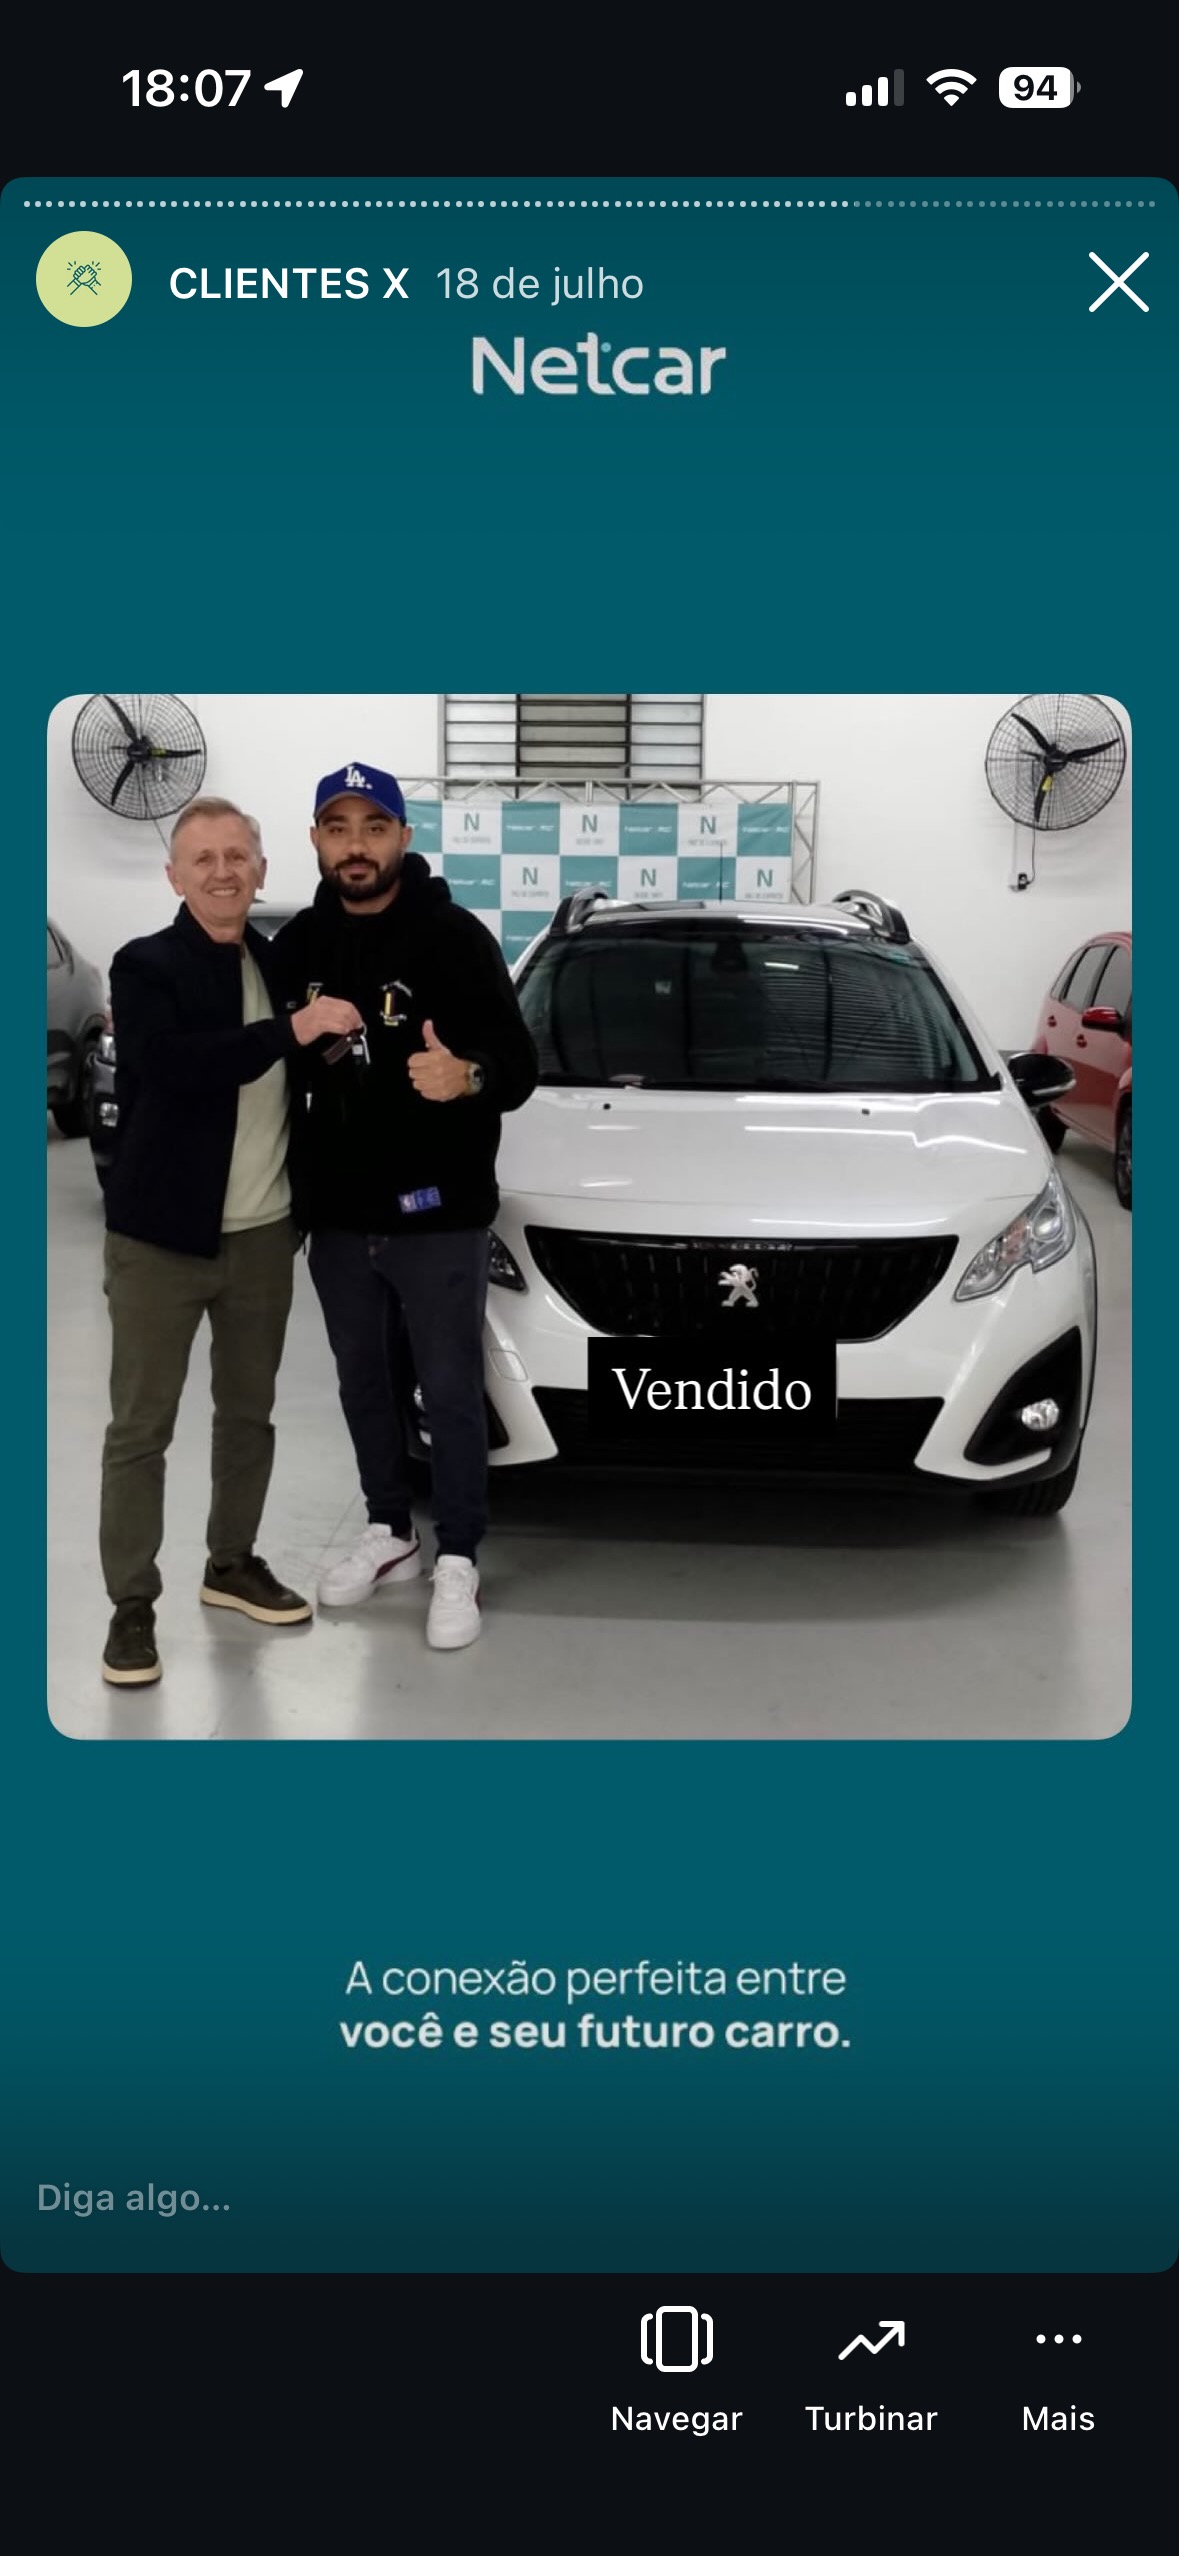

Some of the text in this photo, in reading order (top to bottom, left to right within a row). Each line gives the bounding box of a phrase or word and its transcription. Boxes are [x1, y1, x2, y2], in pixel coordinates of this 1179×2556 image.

[464, 813, 480, 832] N
[582, 814, 598, 833] N
[700, 816, 717, 835] N
[523, 867, 539, 886] N
[641, 868, 657, 887] N
[757, 869, 773, 888] N
